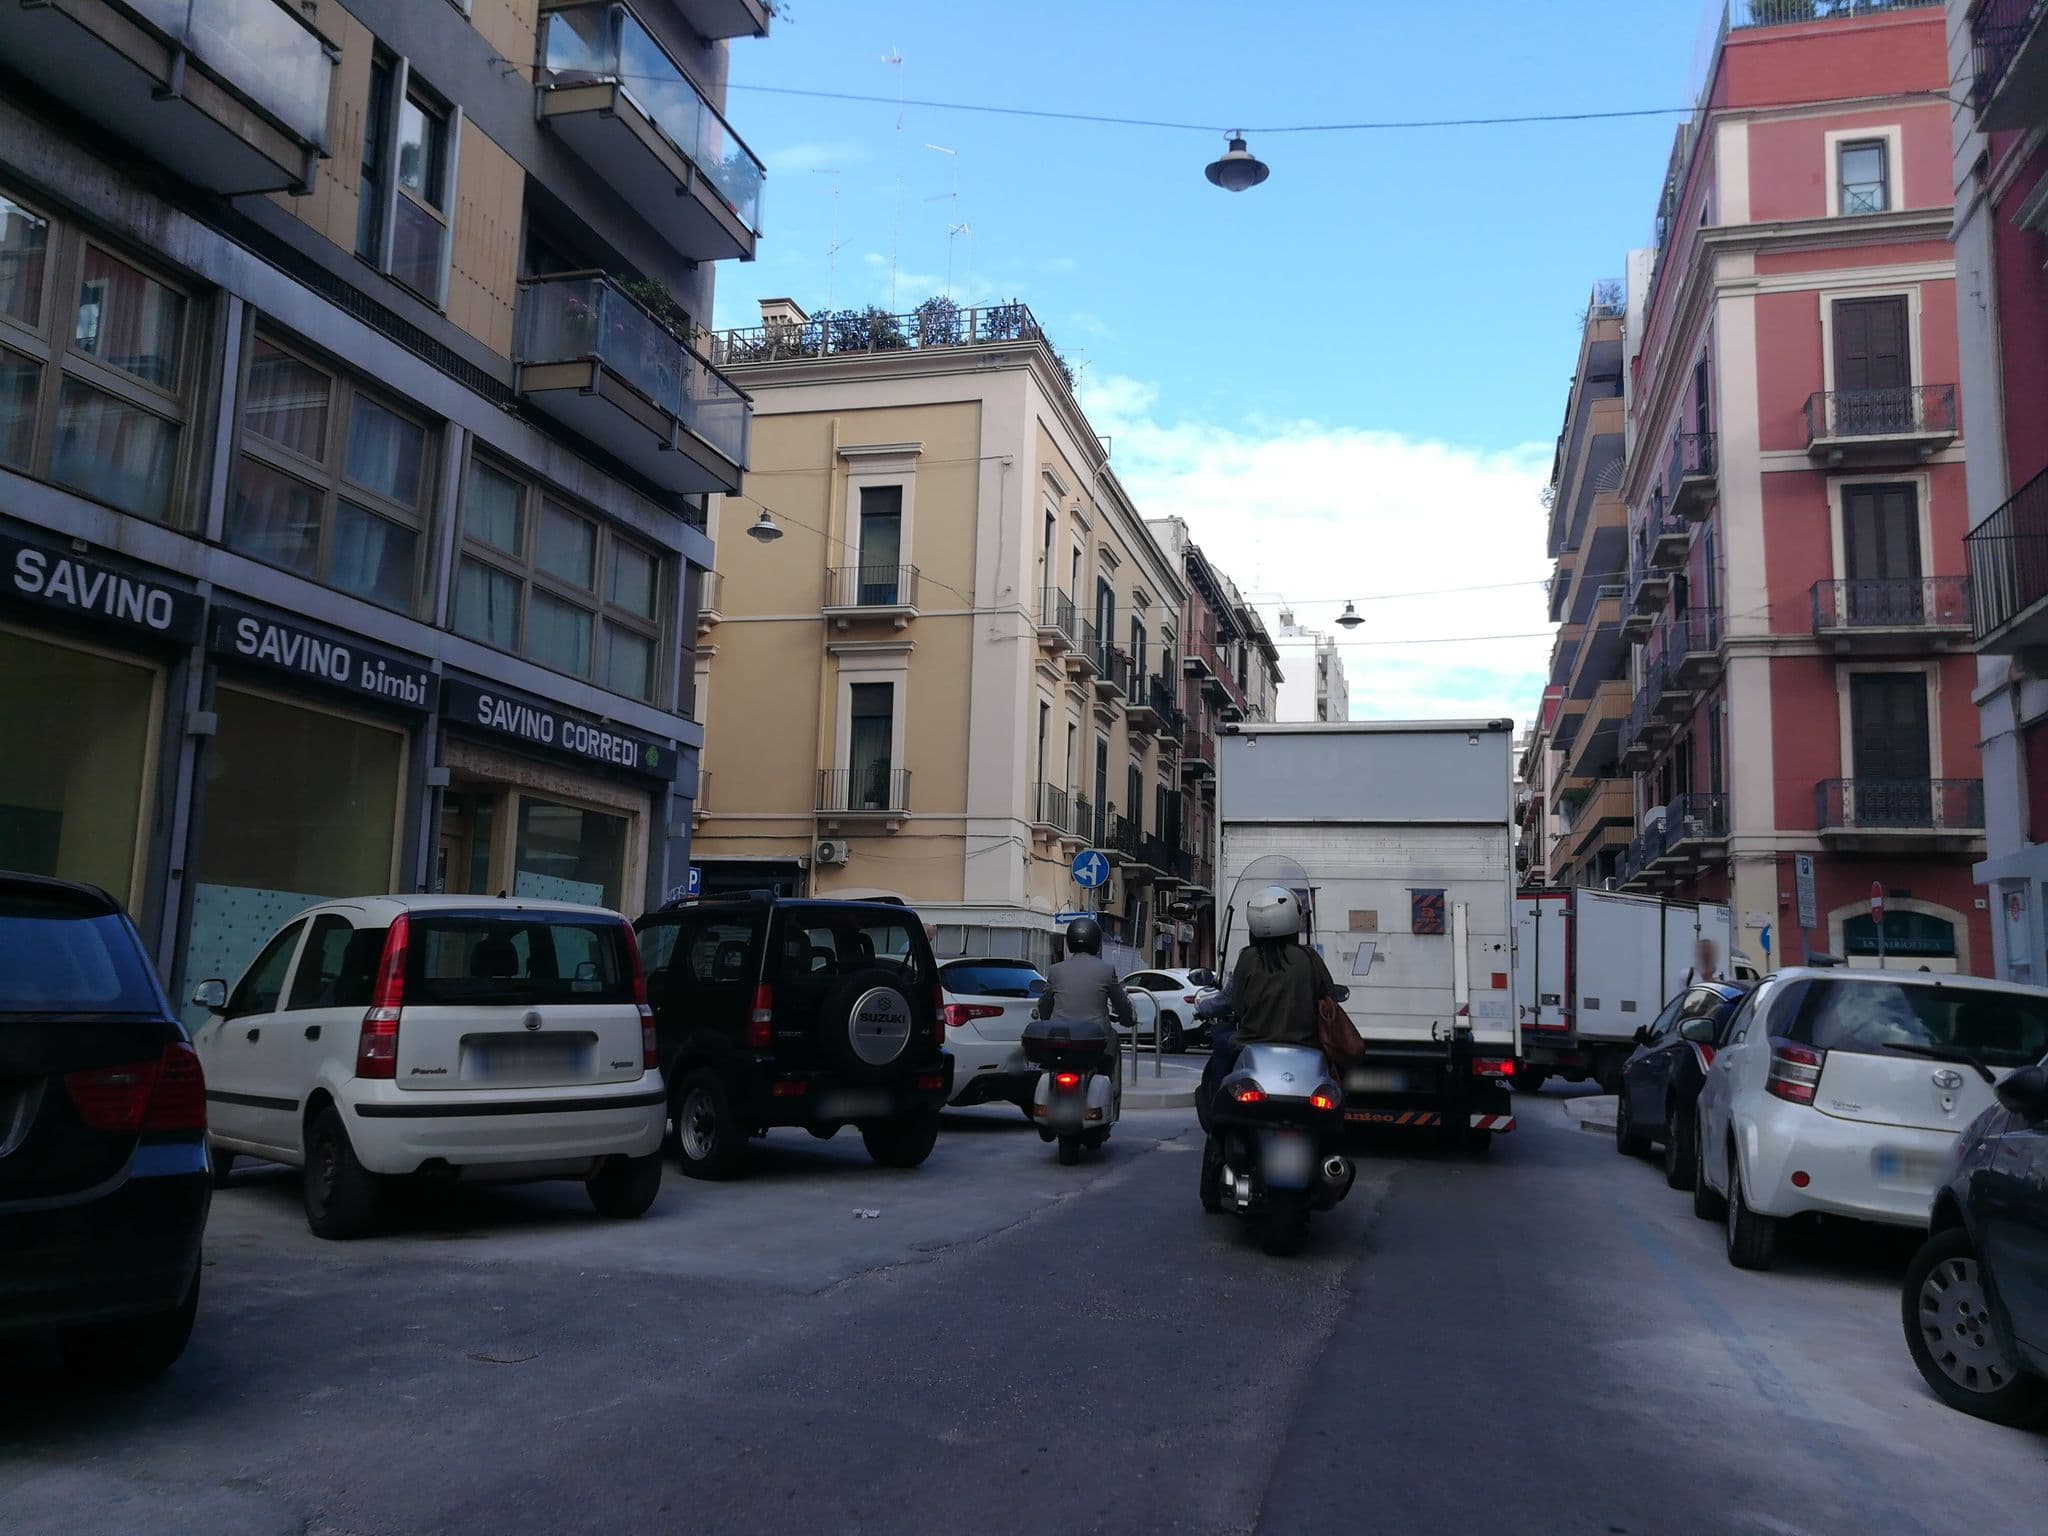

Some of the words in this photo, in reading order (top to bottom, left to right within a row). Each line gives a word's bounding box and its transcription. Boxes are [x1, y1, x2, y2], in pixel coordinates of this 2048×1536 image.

[14, 548, 173, 630] SAVINO
[236, 617, 350, 682] SAVINO
[361, 660, 427, 705] bimbi
[477, 694, 554, 743] SAVINO
[562, 721, 638, 768] CORREDI
[688, 869, 698, 892] P
[860, 1013, 905, 1024] SUZUKI
[1343, 1112, 1394, 1122] anteo
